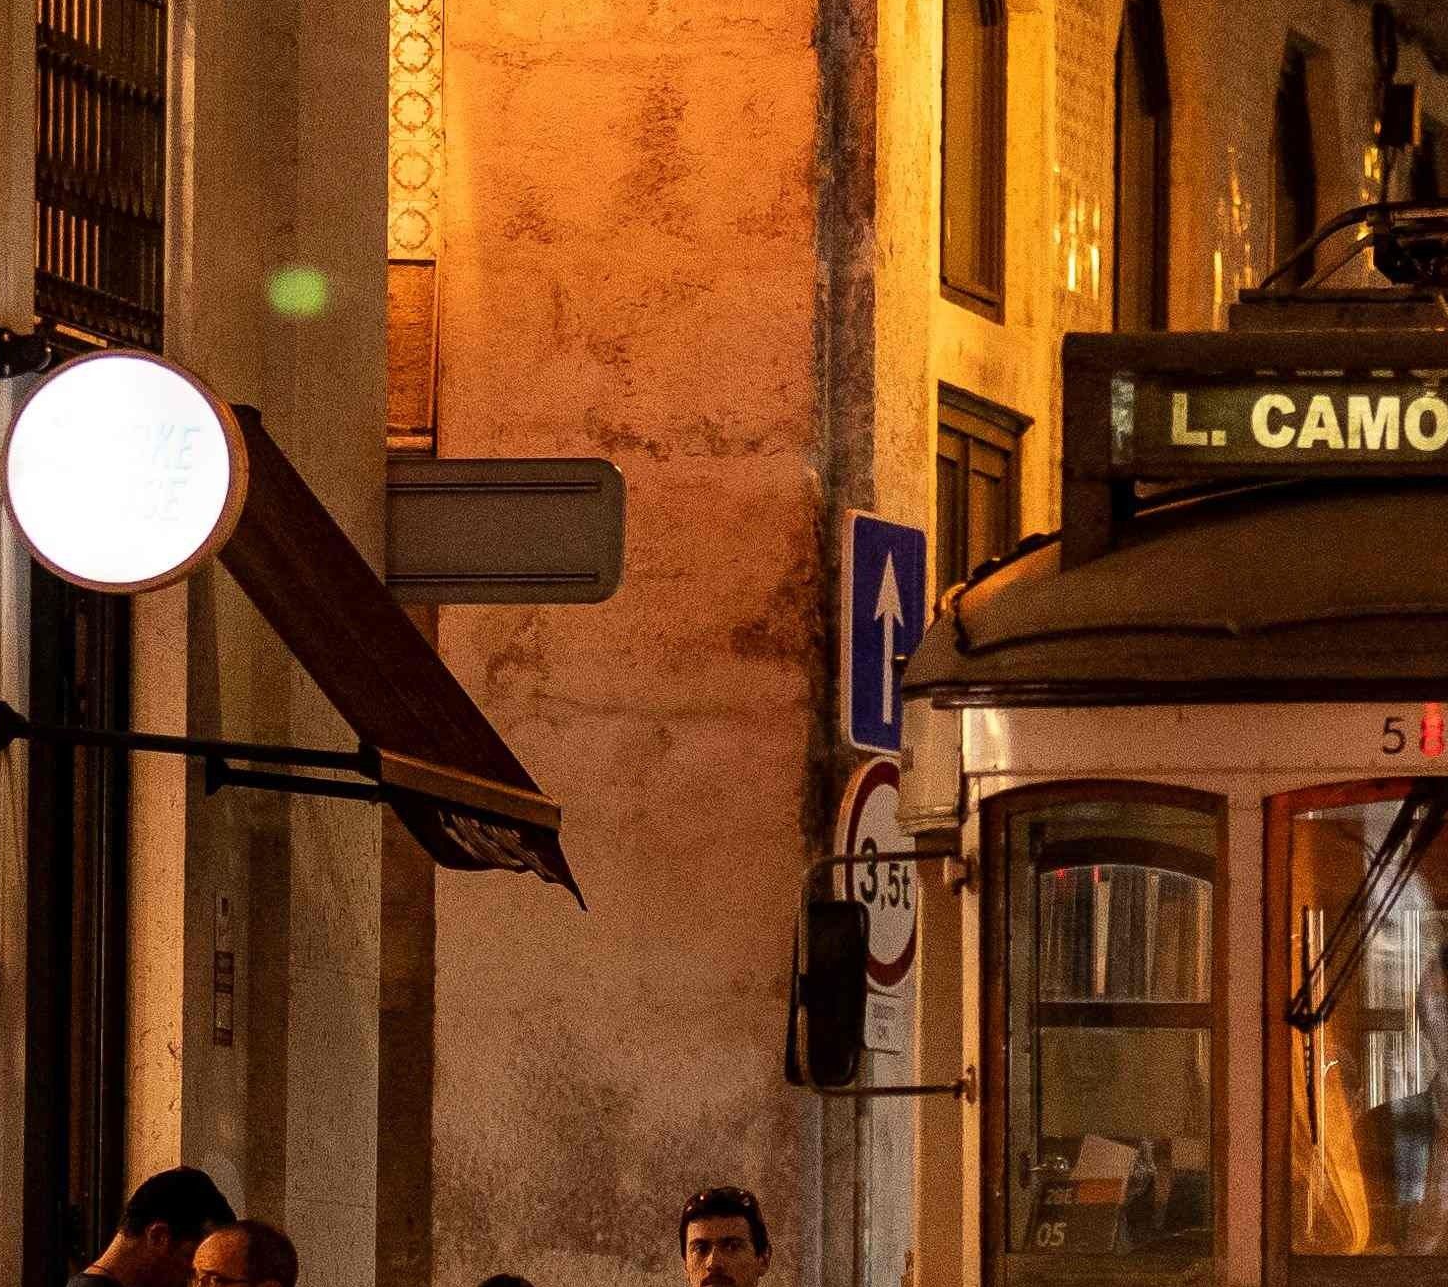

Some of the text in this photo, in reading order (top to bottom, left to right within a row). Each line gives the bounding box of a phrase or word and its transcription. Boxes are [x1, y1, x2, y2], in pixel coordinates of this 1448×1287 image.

[1172, 393, 1226, 447] L.
[860, 837, 911, 911] 3,5t
[1038, 1222, 1066, 1246] 05
